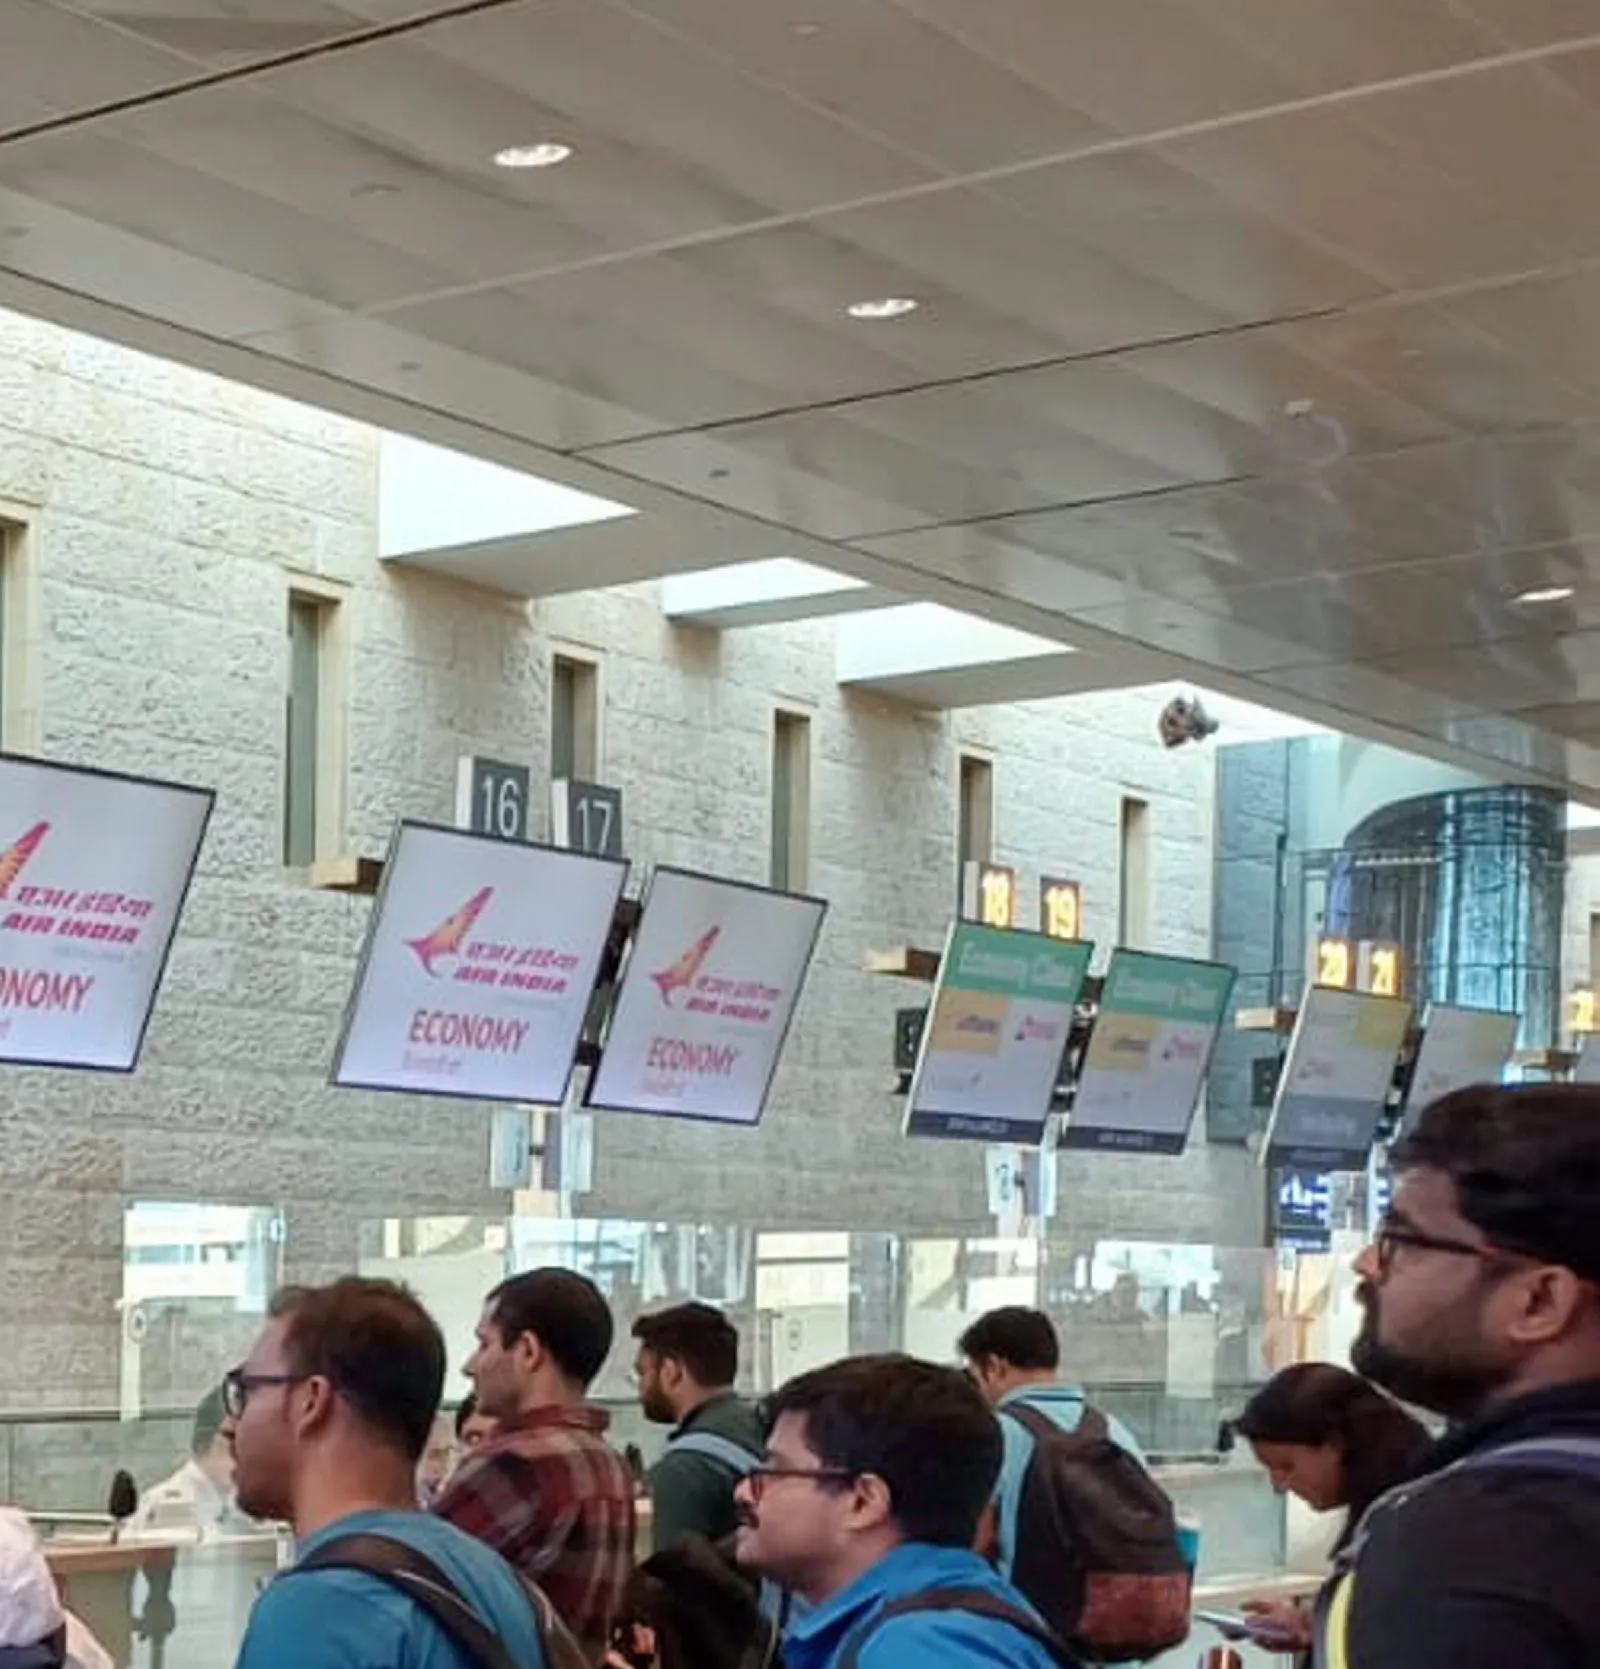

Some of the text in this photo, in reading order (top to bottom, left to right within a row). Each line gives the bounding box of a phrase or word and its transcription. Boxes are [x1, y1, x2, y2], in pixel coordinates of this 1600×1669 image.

[482, 776, 518, 836] 16
[577, 798, 613, 855] 17
[1, 911, 140, 944] AIR INDIA
[1046, 885, 1076, 938] 19
[409, 1008, 530, 1053] ECONOMY
[647, 1036, 739, 1078] ECONOMY
